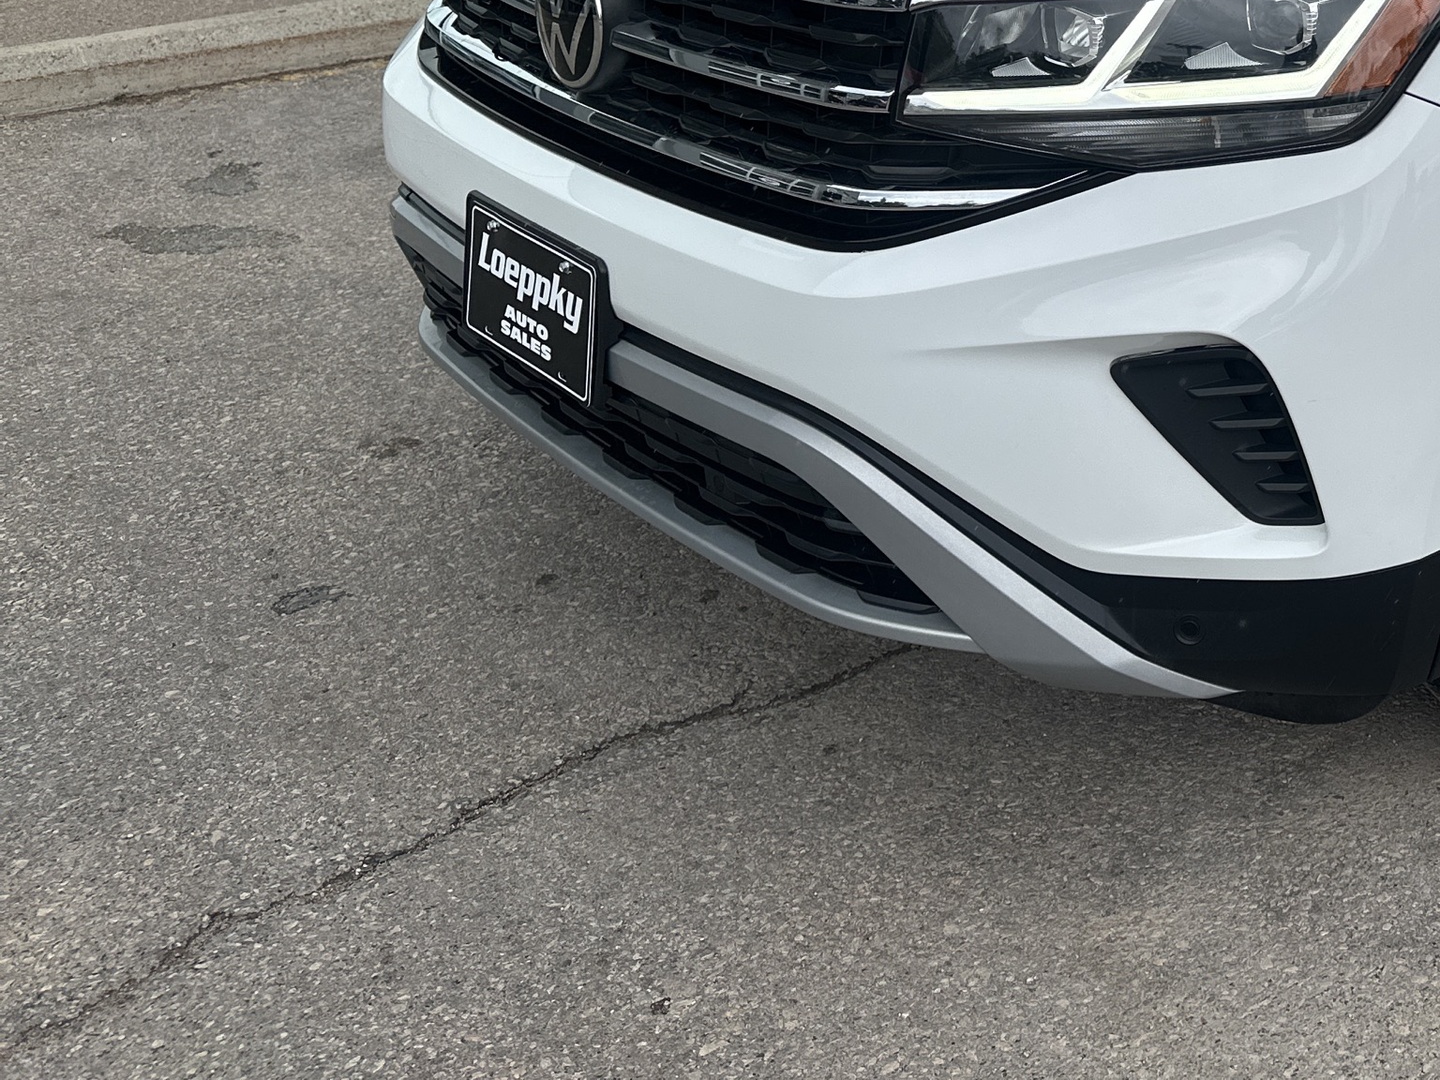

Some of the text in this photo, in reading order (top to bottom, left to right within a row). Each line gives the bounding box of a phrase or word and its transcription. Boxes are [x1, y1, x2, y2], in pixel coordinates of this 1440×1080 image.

[477, 232, 583, 334] Loeppky
[500, 319, 552, 362] SALES
[504, 304, 549, 341] AUTO
